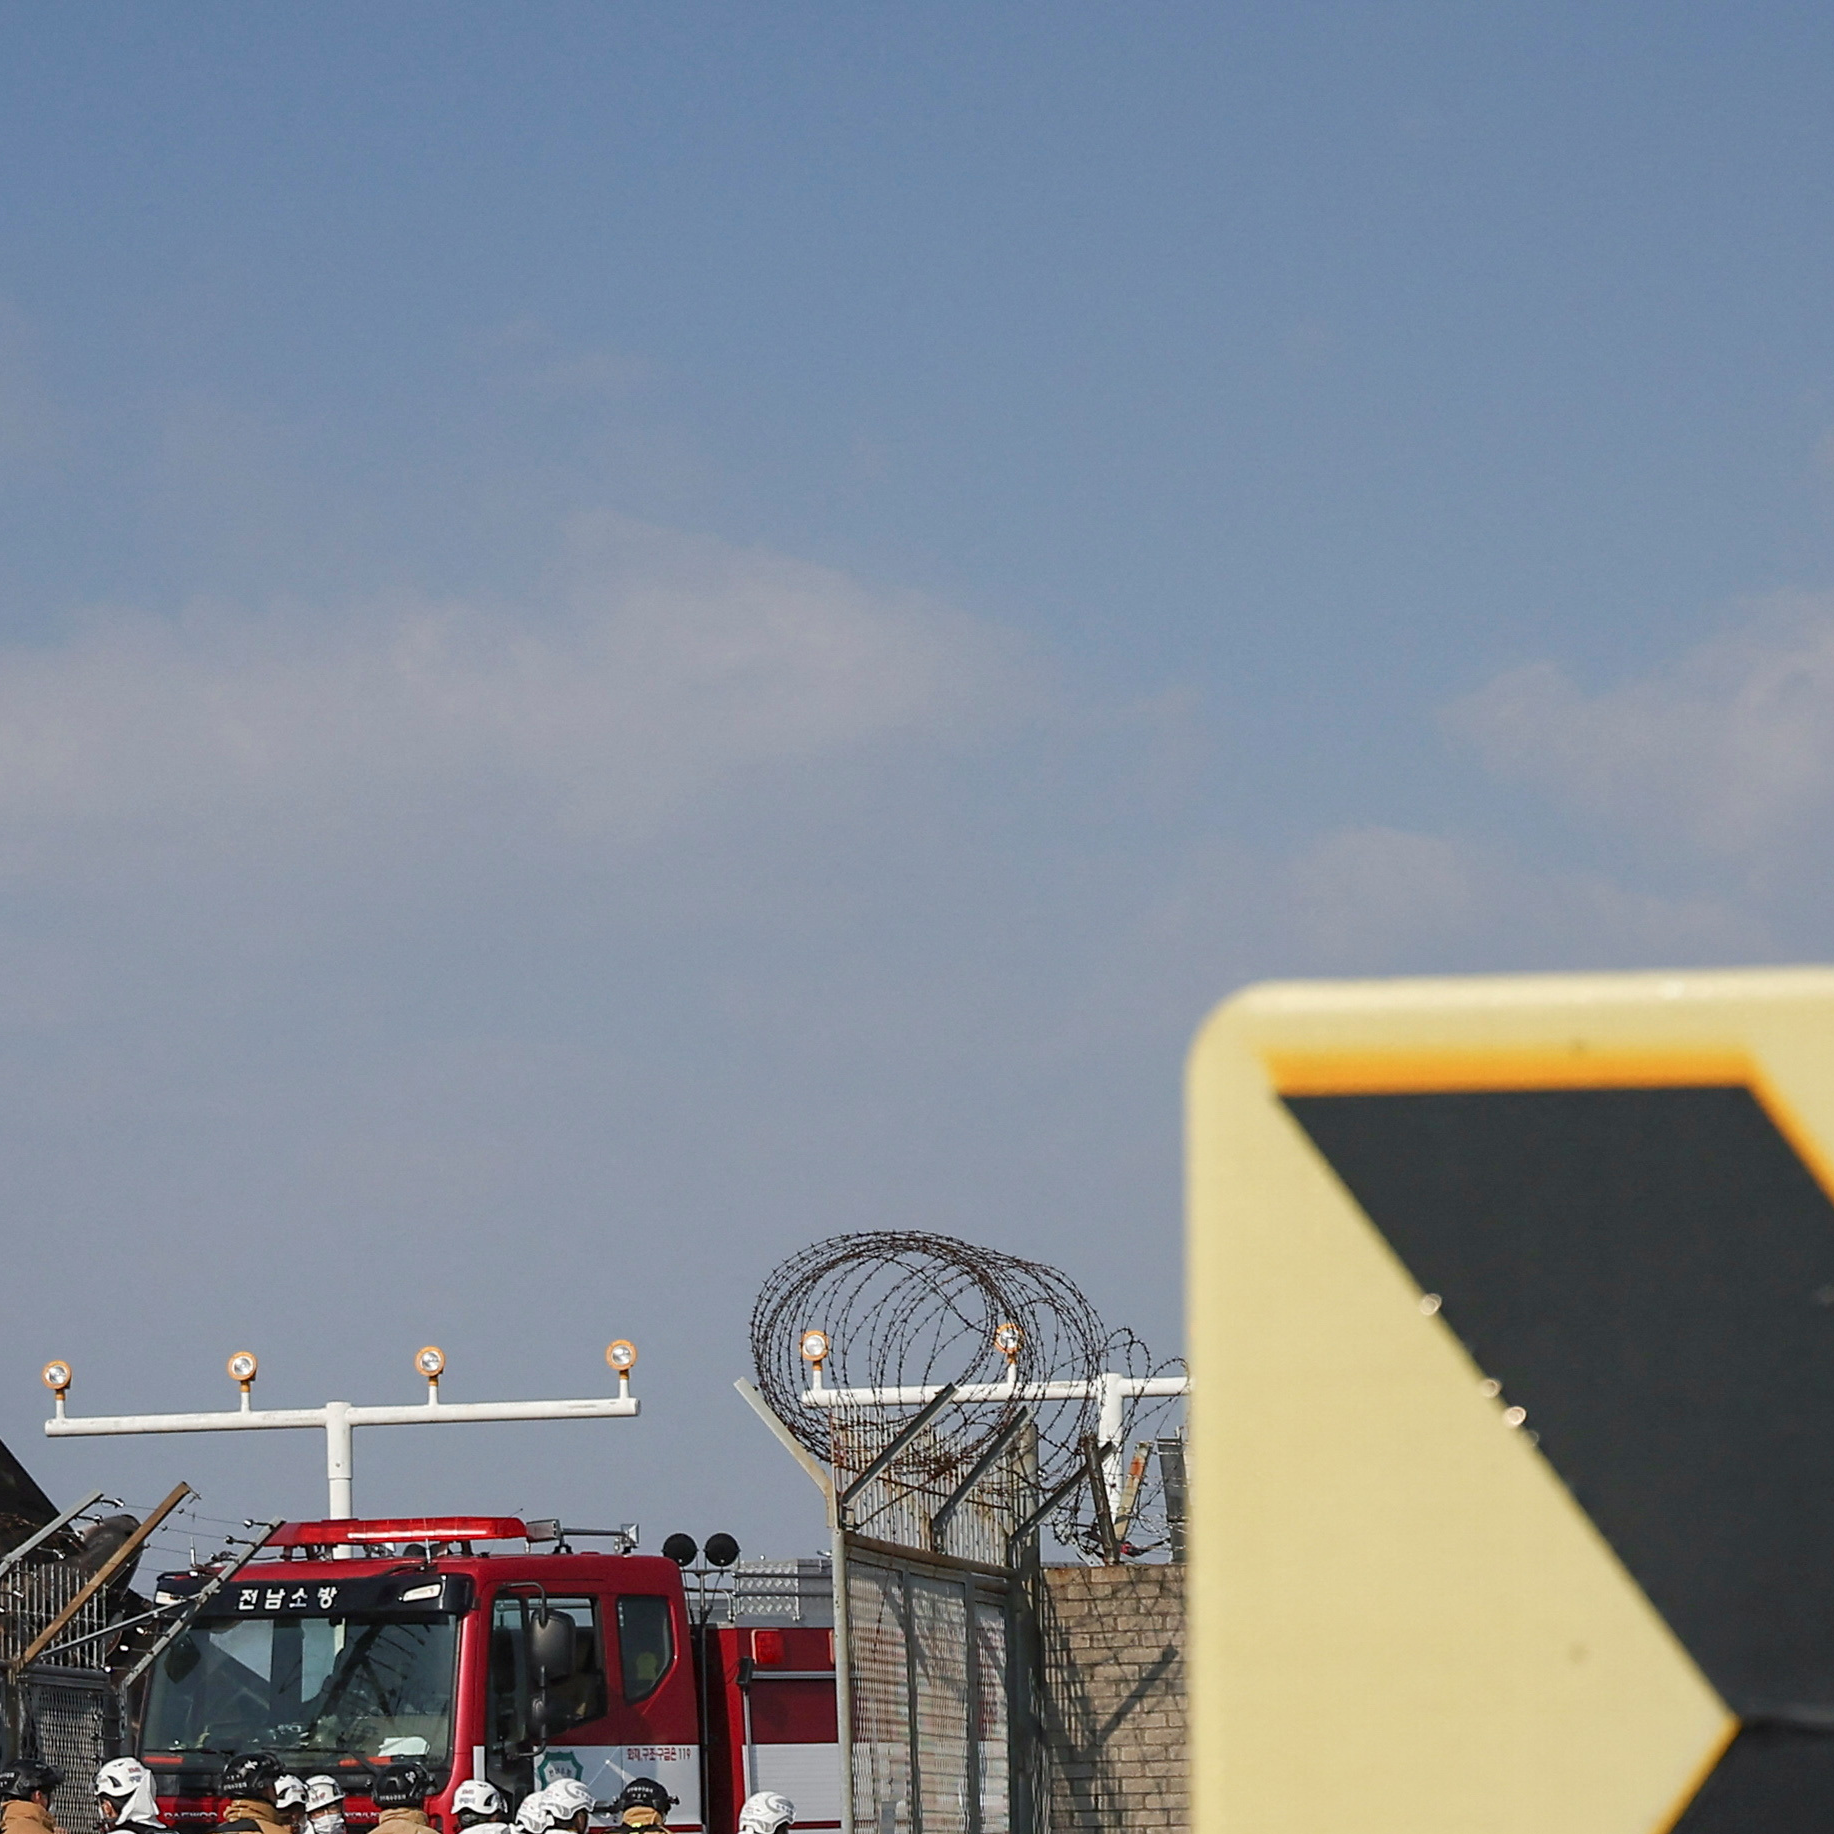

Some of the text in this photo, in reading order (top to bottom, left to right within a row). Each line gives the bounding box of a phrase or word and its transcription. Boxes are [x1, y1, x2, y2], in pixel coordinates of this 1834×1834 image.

[237, 1586, 339, 1611] 전남소방
[678, 1747, 691, 1760] 119
[163, 1811, 218, 1820] DAEWOO
